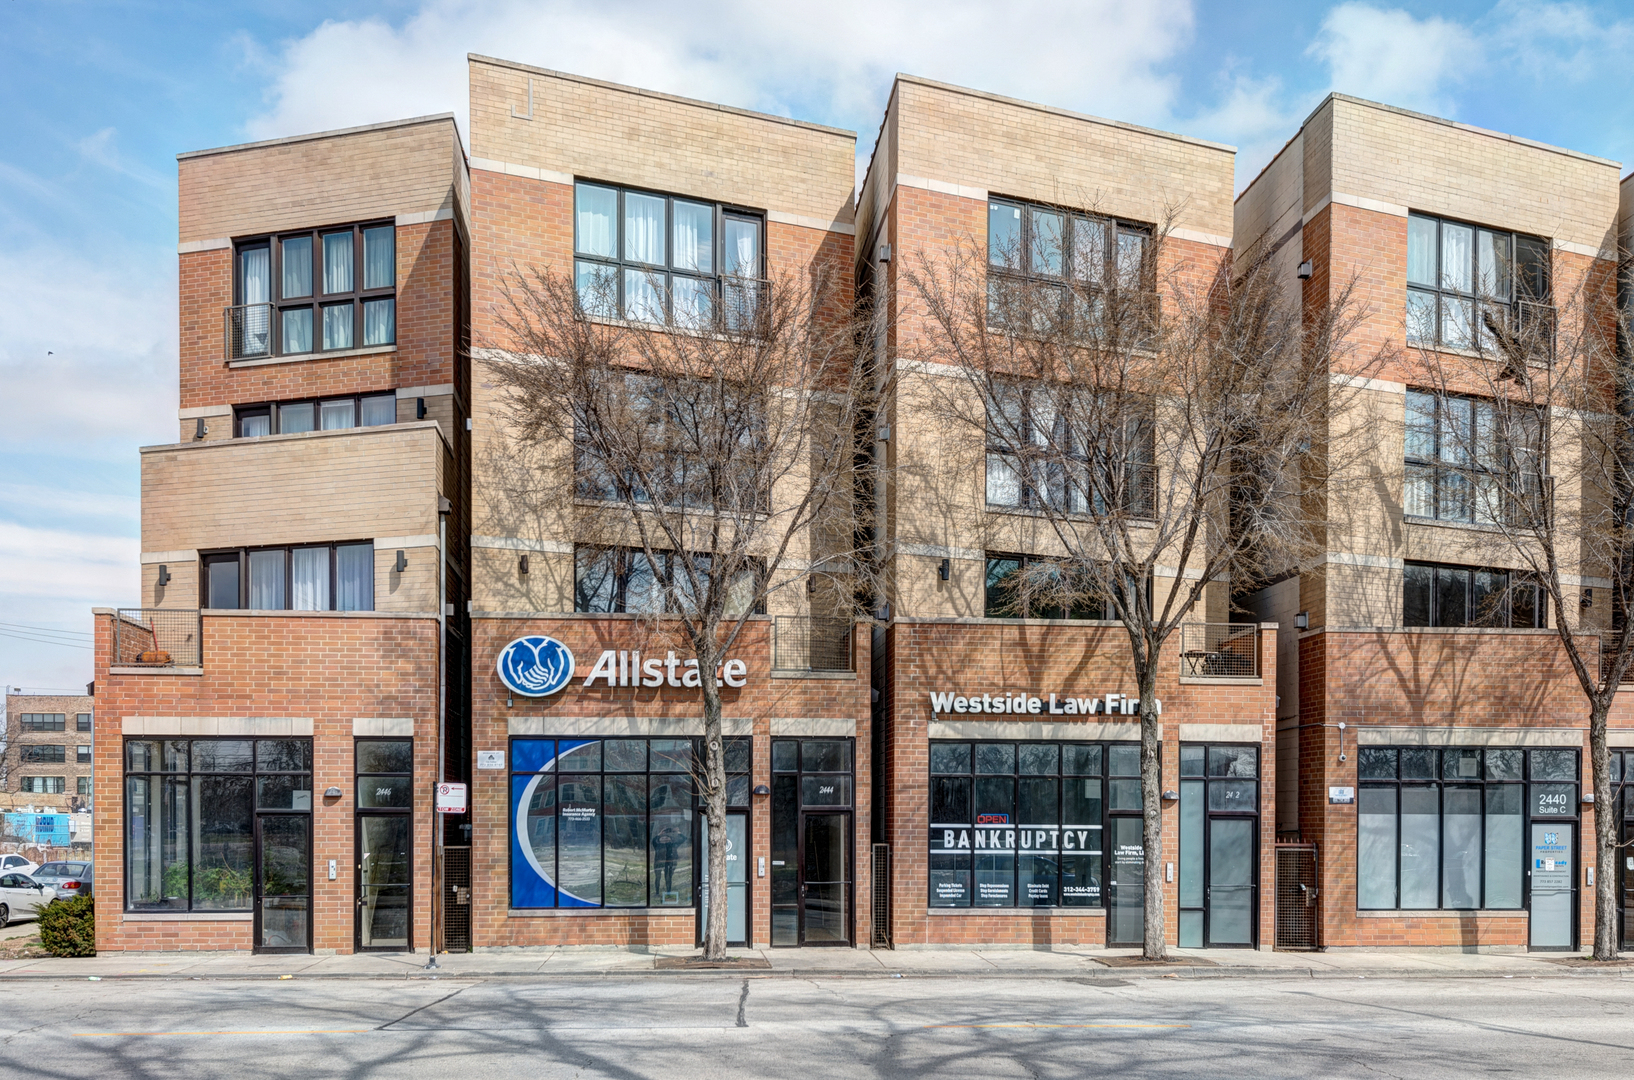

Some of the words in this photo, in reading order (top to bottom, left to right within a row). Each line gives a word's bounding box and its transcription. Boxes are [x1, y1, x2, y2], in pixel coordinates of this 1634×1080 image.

[930, 691, 1042, 714] Westside
[1049, 693, 1099, 715] Law
[1105, 693, 1162, 715] Fir
[375, 787, 392, 796] 2446
[819, 785, 834, 794] 2444
[1539, 794, 1567, 805] 2440
[1538, 805, 1558, 814] Suite
[1559, 805, 1567, 814] C
[977, 815, 1007, 824] OPEN
[943, 829, 1088, 849] BANKRUPTCY
